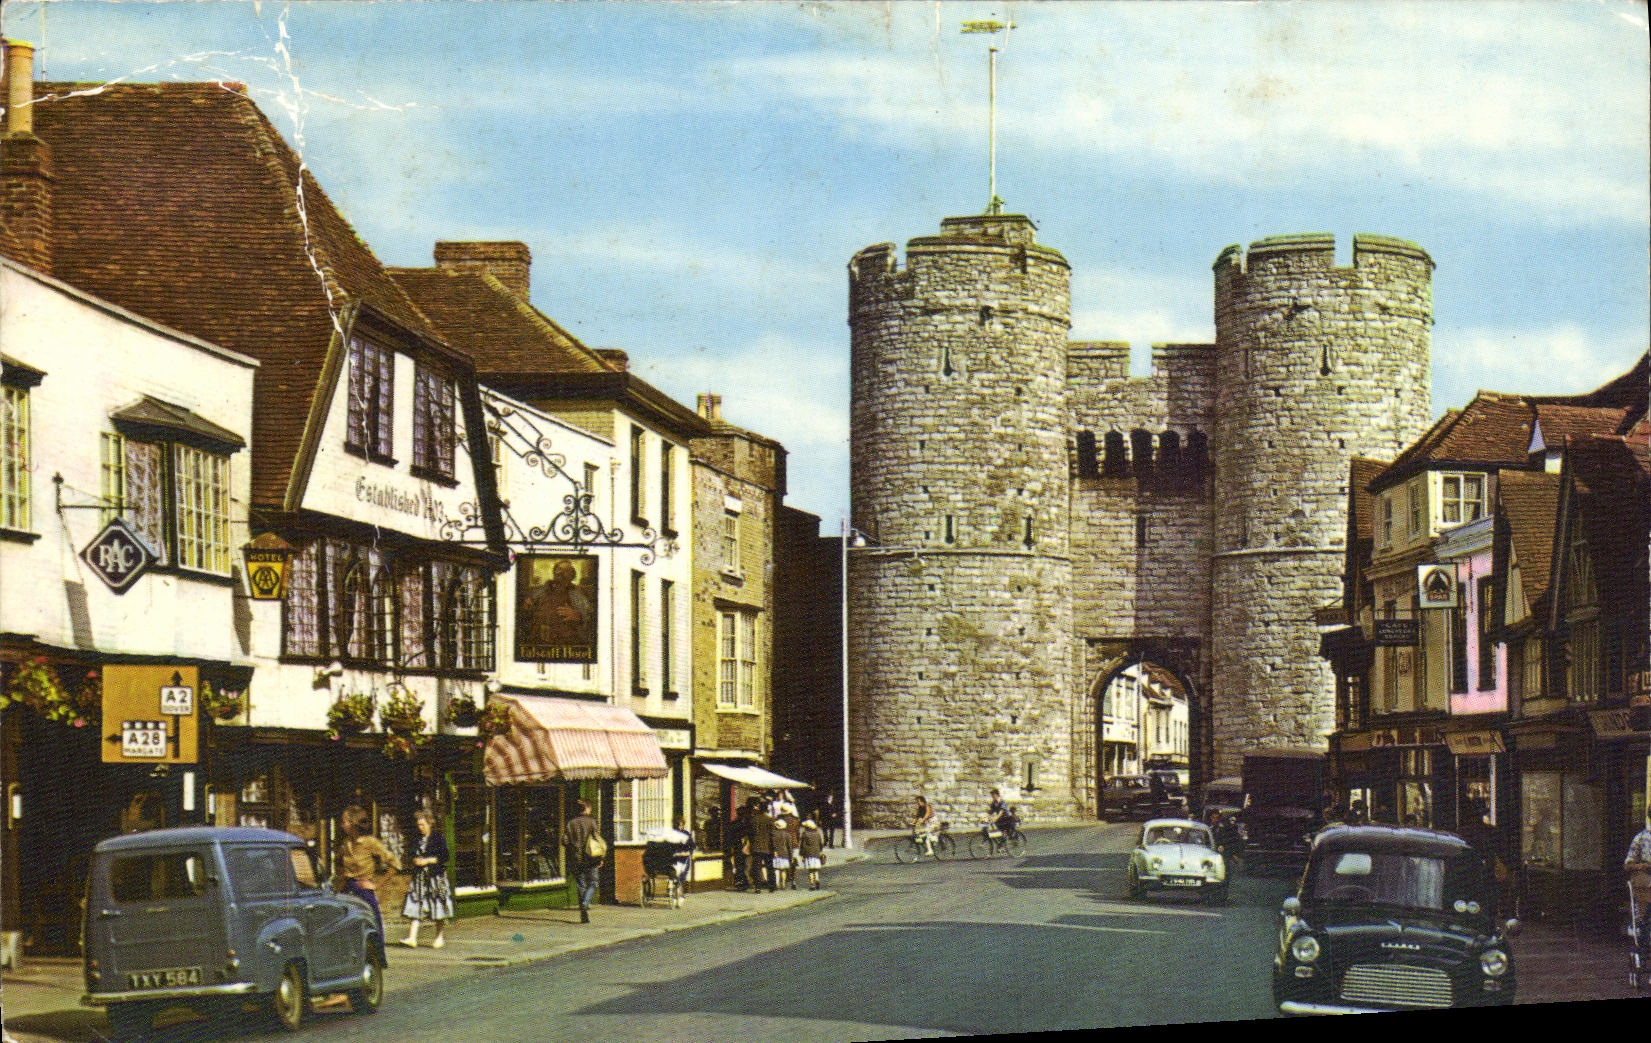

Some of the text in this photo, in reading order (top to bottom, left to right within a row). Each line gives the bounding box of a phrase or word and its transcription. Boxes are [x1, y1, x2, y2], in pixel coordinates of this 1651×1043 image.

[99, 538, 134, 572] RAC
[251, 553, 283, 561] HOTEL
[165, 690, 187, 703] A2
[128, 732, 161, 745] A28
